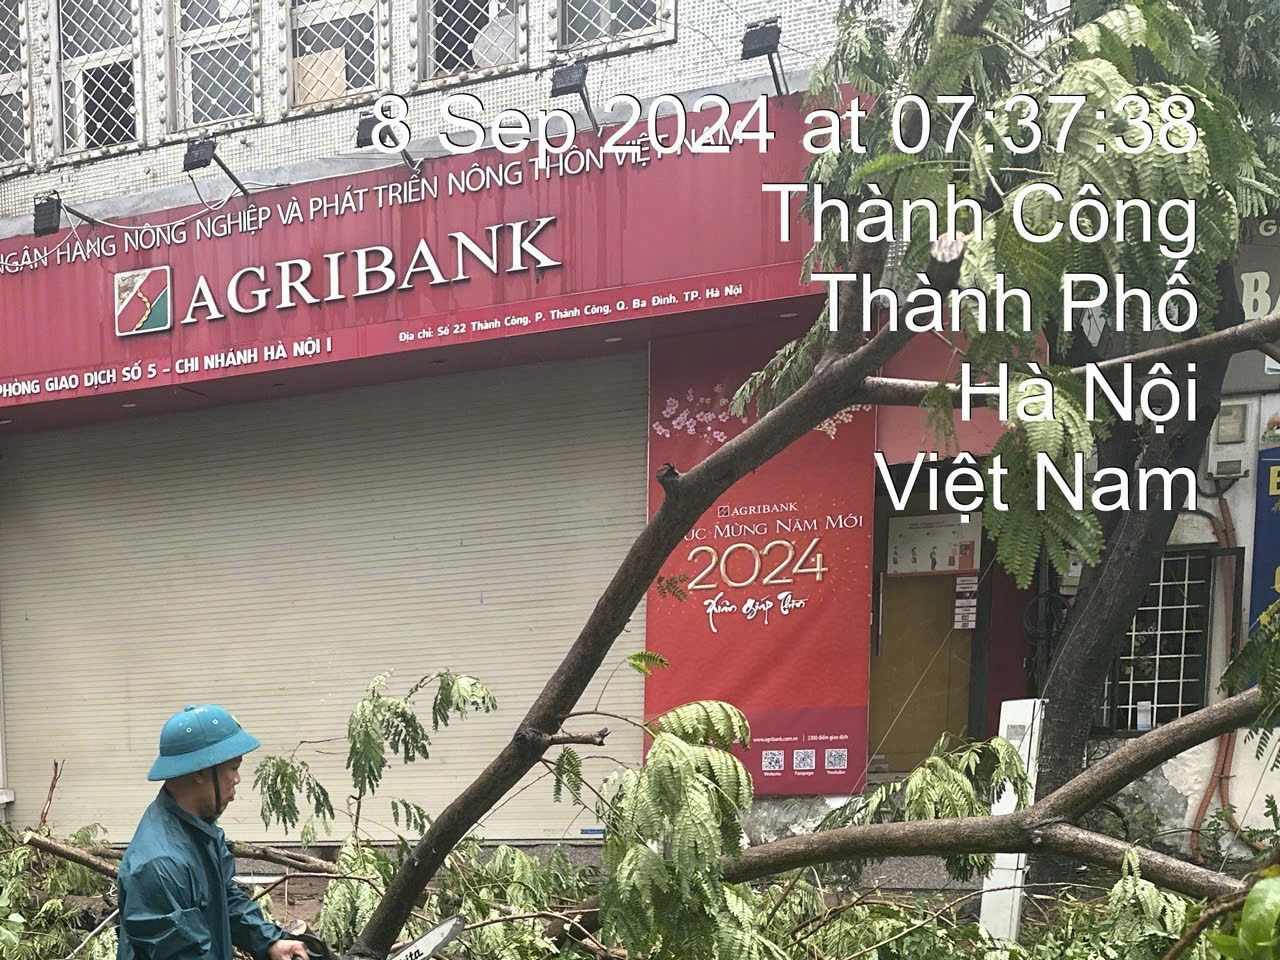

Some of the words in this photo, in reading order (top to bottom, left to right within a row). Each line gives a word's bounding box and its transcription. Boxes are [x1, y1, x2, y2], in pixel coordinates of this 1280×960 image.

[56, 235, 116, 264] HÀNG
[124, 223, 186, 253] NÔNG
[195, 204, 271, 239] NGHIỆP
[277, 196, 303, 224] VÀ
[310, 184, 368, 220] PHÁT
[375, 164, 438, 208] TRIỂN
[449, 157, 523, 195] NÔNG
[528, 145, 604, 180] THÔN
[180, 216, 563, 324] AGRIBANK
[399, 332, 414, 343] Địa
[417, 327, 434, 339] chỉ:
[437, 325, 449, 337] Số
[453, 323, 466, 334] 22
[471, 319, 501, 331] Thành
[504, 315, 531, 327] Công,
[535, 312, 546, 322] P.
[549, 307, 580, 320] Thành
[584, 304, 612, 315] Công,
[616, 301, 628, 311] Q.
[632, 298, 647, 309] Ba
[651, 294, 679, 306] Đình,
[683, 290, 701, 301] TP.
[706, 288, 720, 299] Hà
[725, 284, 743, 297] Nội
[45, 373, 79, 393] GIAO
[83, 367, 117, 390] DỊCH
[122, 360, 142, 382] SỐ
[147, 364, 158, 380] 5
[175, 354, 200, 375] CHI
[204, 346, 259, 370] NHÁNH
[263, 341, 288, 362] HÀ
[293, 336, 322, 358] NỘI
[326, 336, 332, 353] I
[714, 521, 768, 539] MỪNG
[776, 518, 817, 534] NĂM
[825, 512, 863, 529] MỚI
[731, 502, 798, 517] AGRIBANK
[687, 537, 829, 591] 2024
